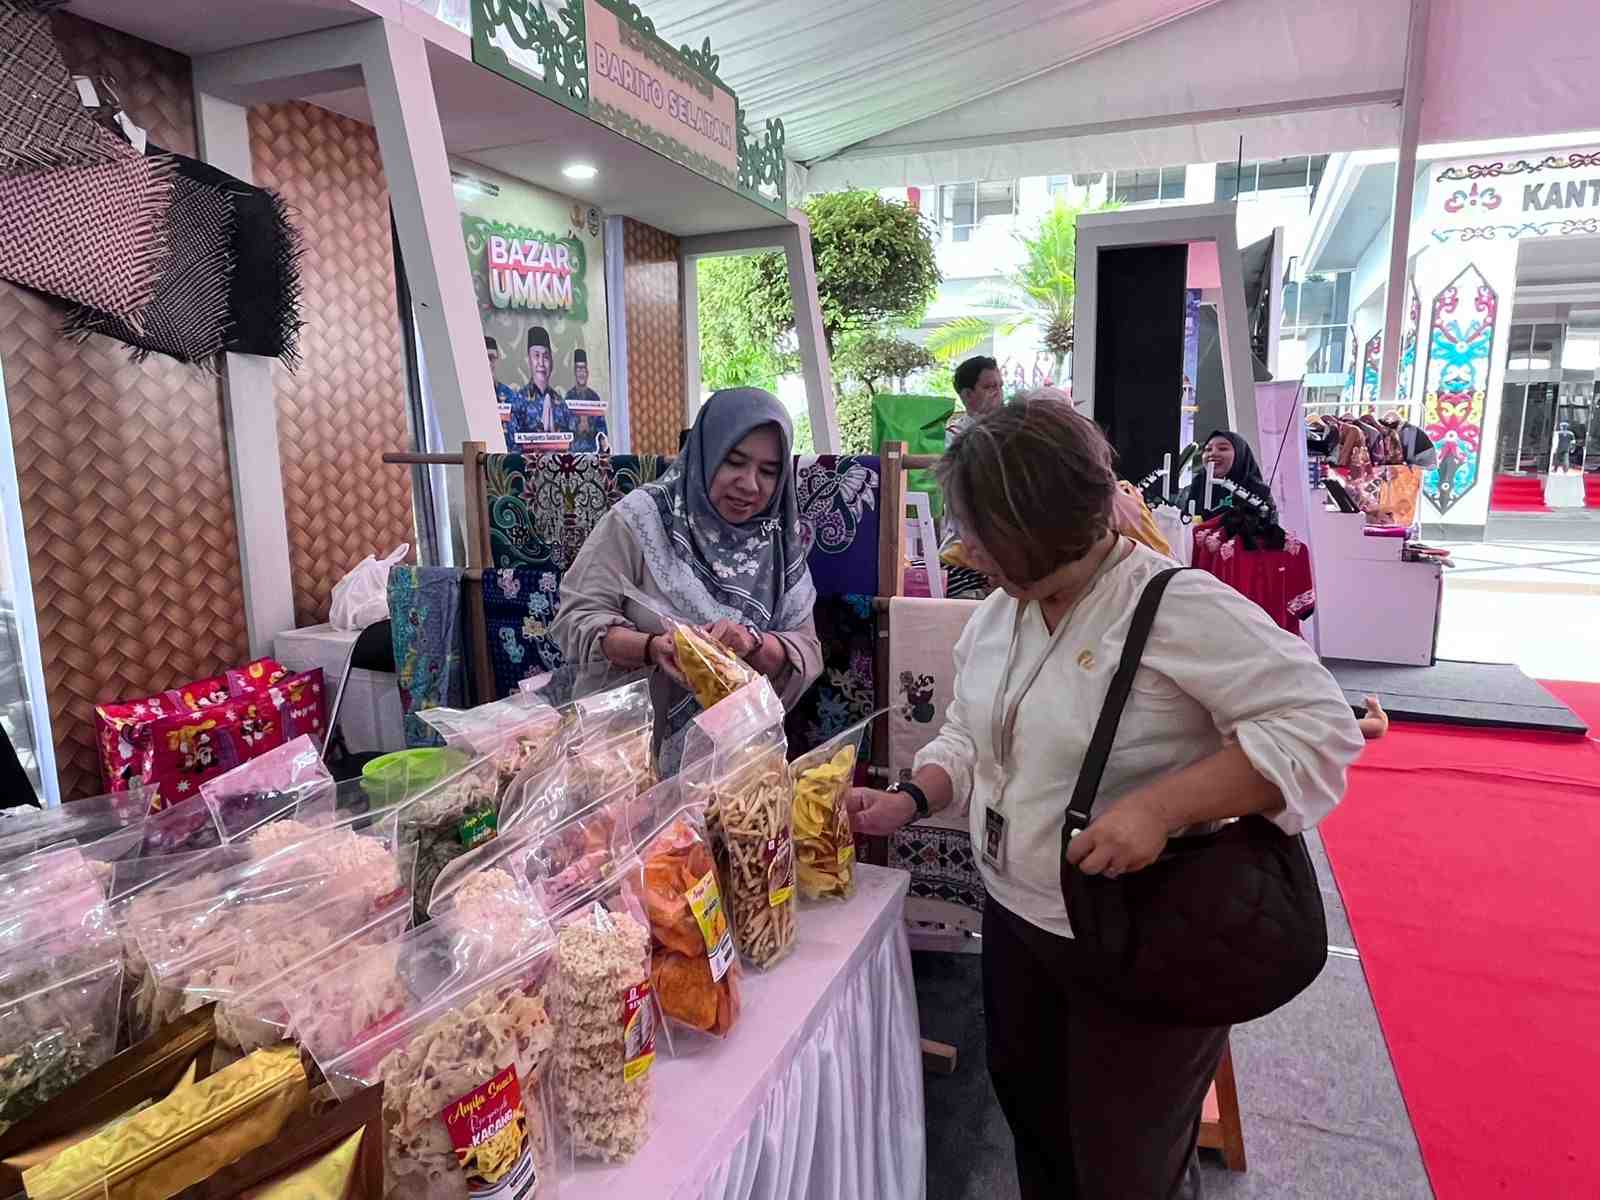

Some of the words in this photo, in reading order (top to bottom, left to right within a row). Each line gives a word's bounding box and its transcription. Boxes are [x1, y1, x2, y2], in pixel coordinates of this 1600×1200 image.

[594, 42, 665, 111] BARITO
[667, 89, 733, 152] SELATAN
[1521, 179, 1600, 212] KANT
[489, 235, 571, 270] BAZAR
[489, 268, 573, 307] UMKM
[472, 1108, 513, 1147] KACANG
